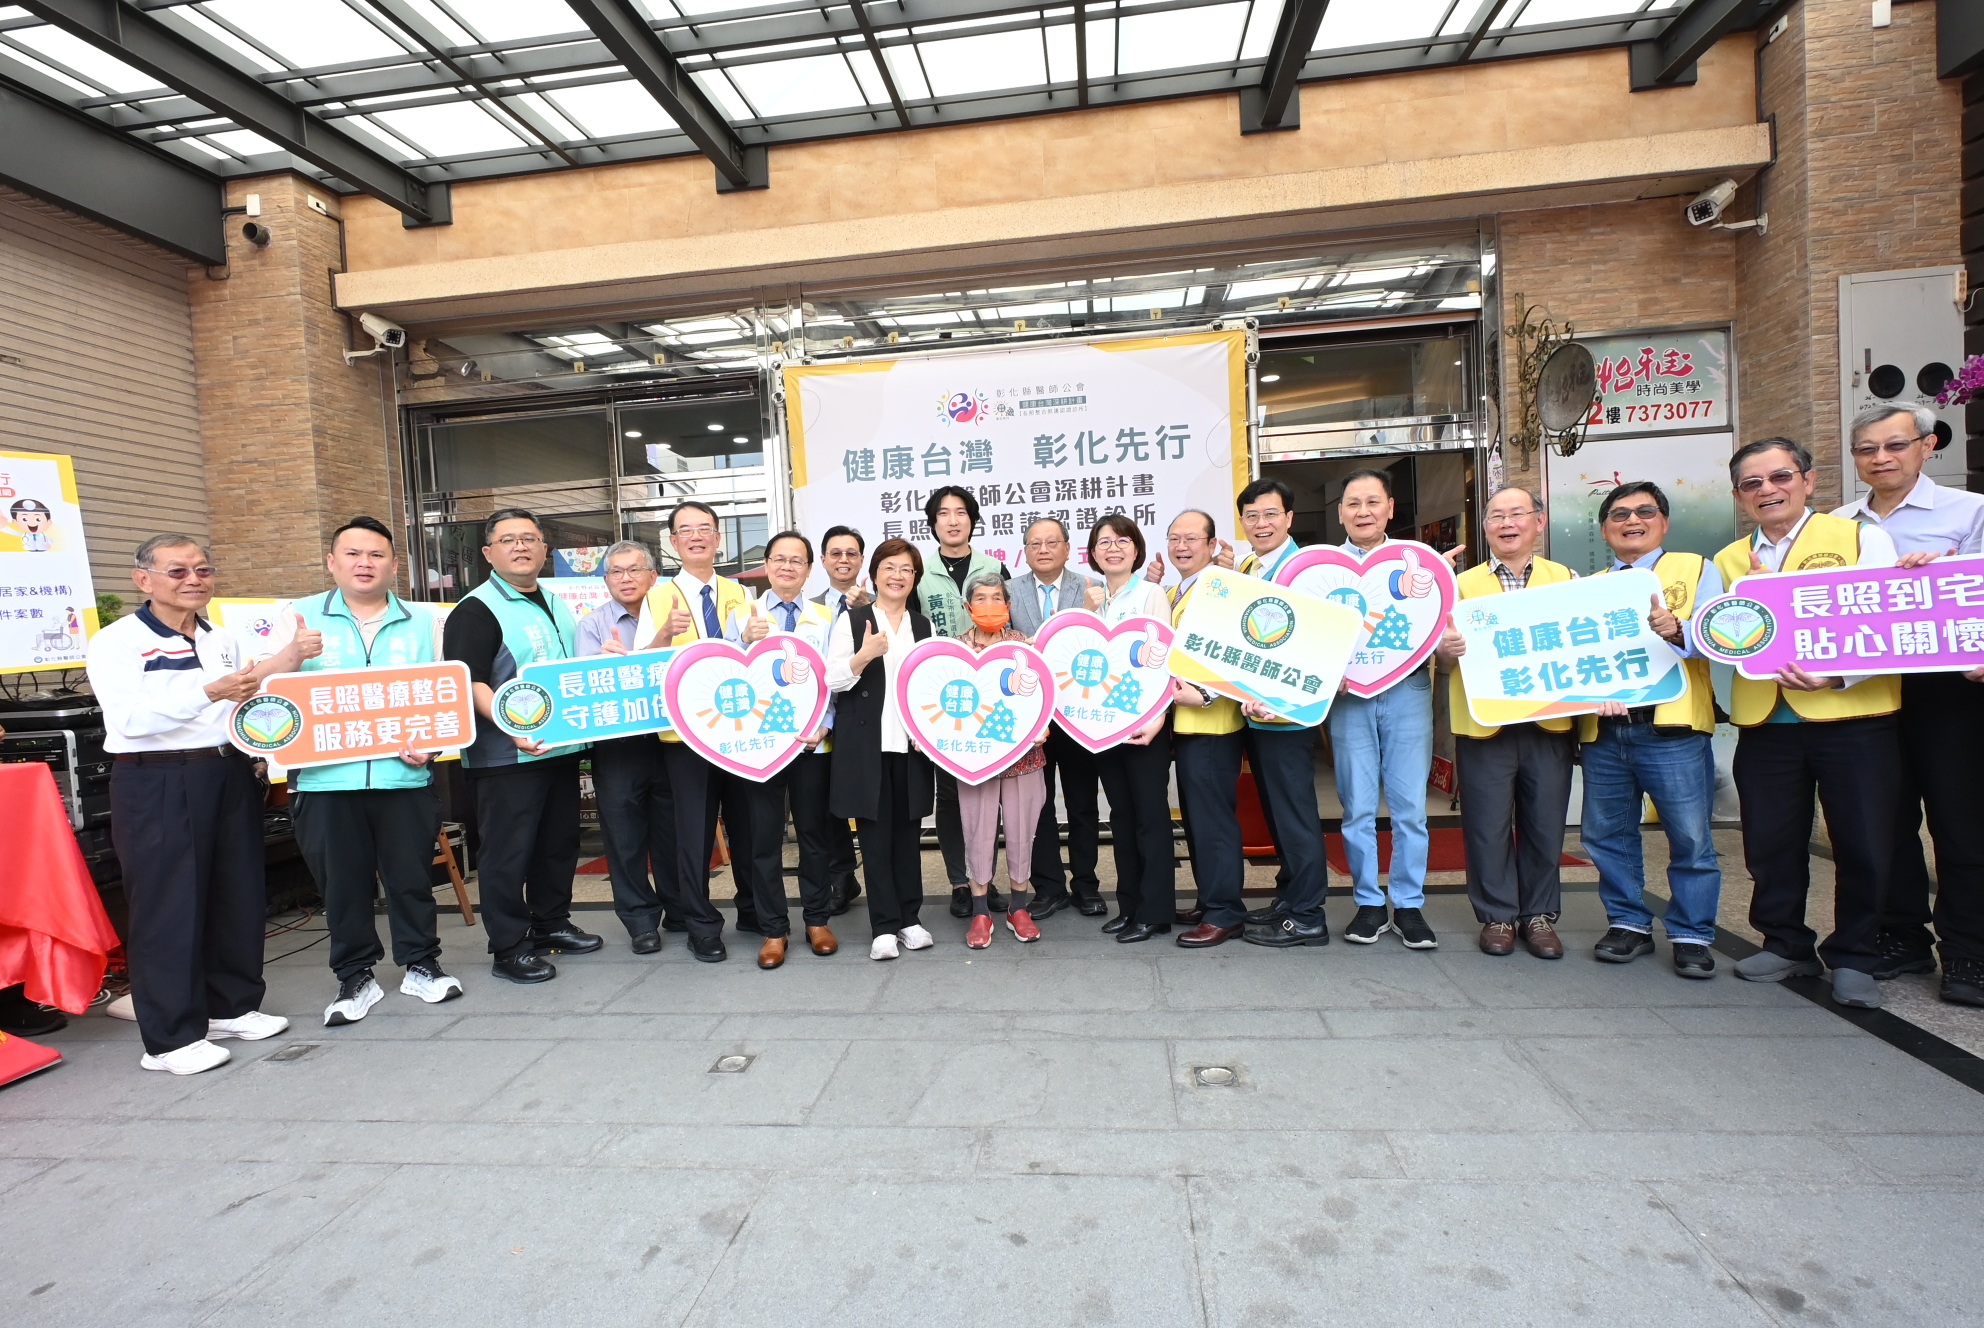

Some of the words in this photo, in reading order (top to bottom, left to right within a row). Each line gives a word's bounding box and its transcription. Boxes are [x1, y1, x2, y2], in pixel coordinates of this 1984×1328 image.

[996, 381, 1085, 398] 彰化縣醫師公會
[1636, 379, 1701, 397] 時尚美學
[1588, 401, 1621, 425] 2樓
[1625, 399, 1714, 423] 7373077
[842, 438, 994, 483] 健康台灣
[1033, 423, 1191, 469] 彰化先行
[882, 502, 1156, 542] 長照合照護認證所
[0, 584, 72, 598] 居家&機構)
[1790, 573, 1984, 619] 長照到宅
[1246, 635, 1267, 648] MEDICAL
[1492, 606, 1641, 659] 健康台灣
[1702, 618, 1716, 648] CHANGHUA
[1719, 647, 1750, 655] MEDICAL
[1753, 614, 1773, 650] ASSOCIATION
[1794, 616, 1984, 660] 貼心關懷
[1077, 653, 1105, 669] 健康
[1184, 633, 1324, 695] 彰化縣醫師公會
[1348, 650, 1386, 665] 先行
[1075, 667, 1103, 682] 台灣
[1500, 647, 1650, 697] 彰化先行
[309, 676, 459, 716] 長照醫療整合
[719, 683, 749, 700] 健康
[945, 684, 974, 699] 健康
[721, 697, 750, 714] 台灣
[945, 699, 974, 713] 台灣
[1063, 705, 1116, 723] 彰化先行
[236, 714, 250, 742] CHANGHUA
[283, 709, 300, 743] ASSOCIATION
[313, 710, 460, 753] 服務更完善
[719, 735, 776, 755] 彰化先行
[936, 738, 992, 754] 彰化先行
